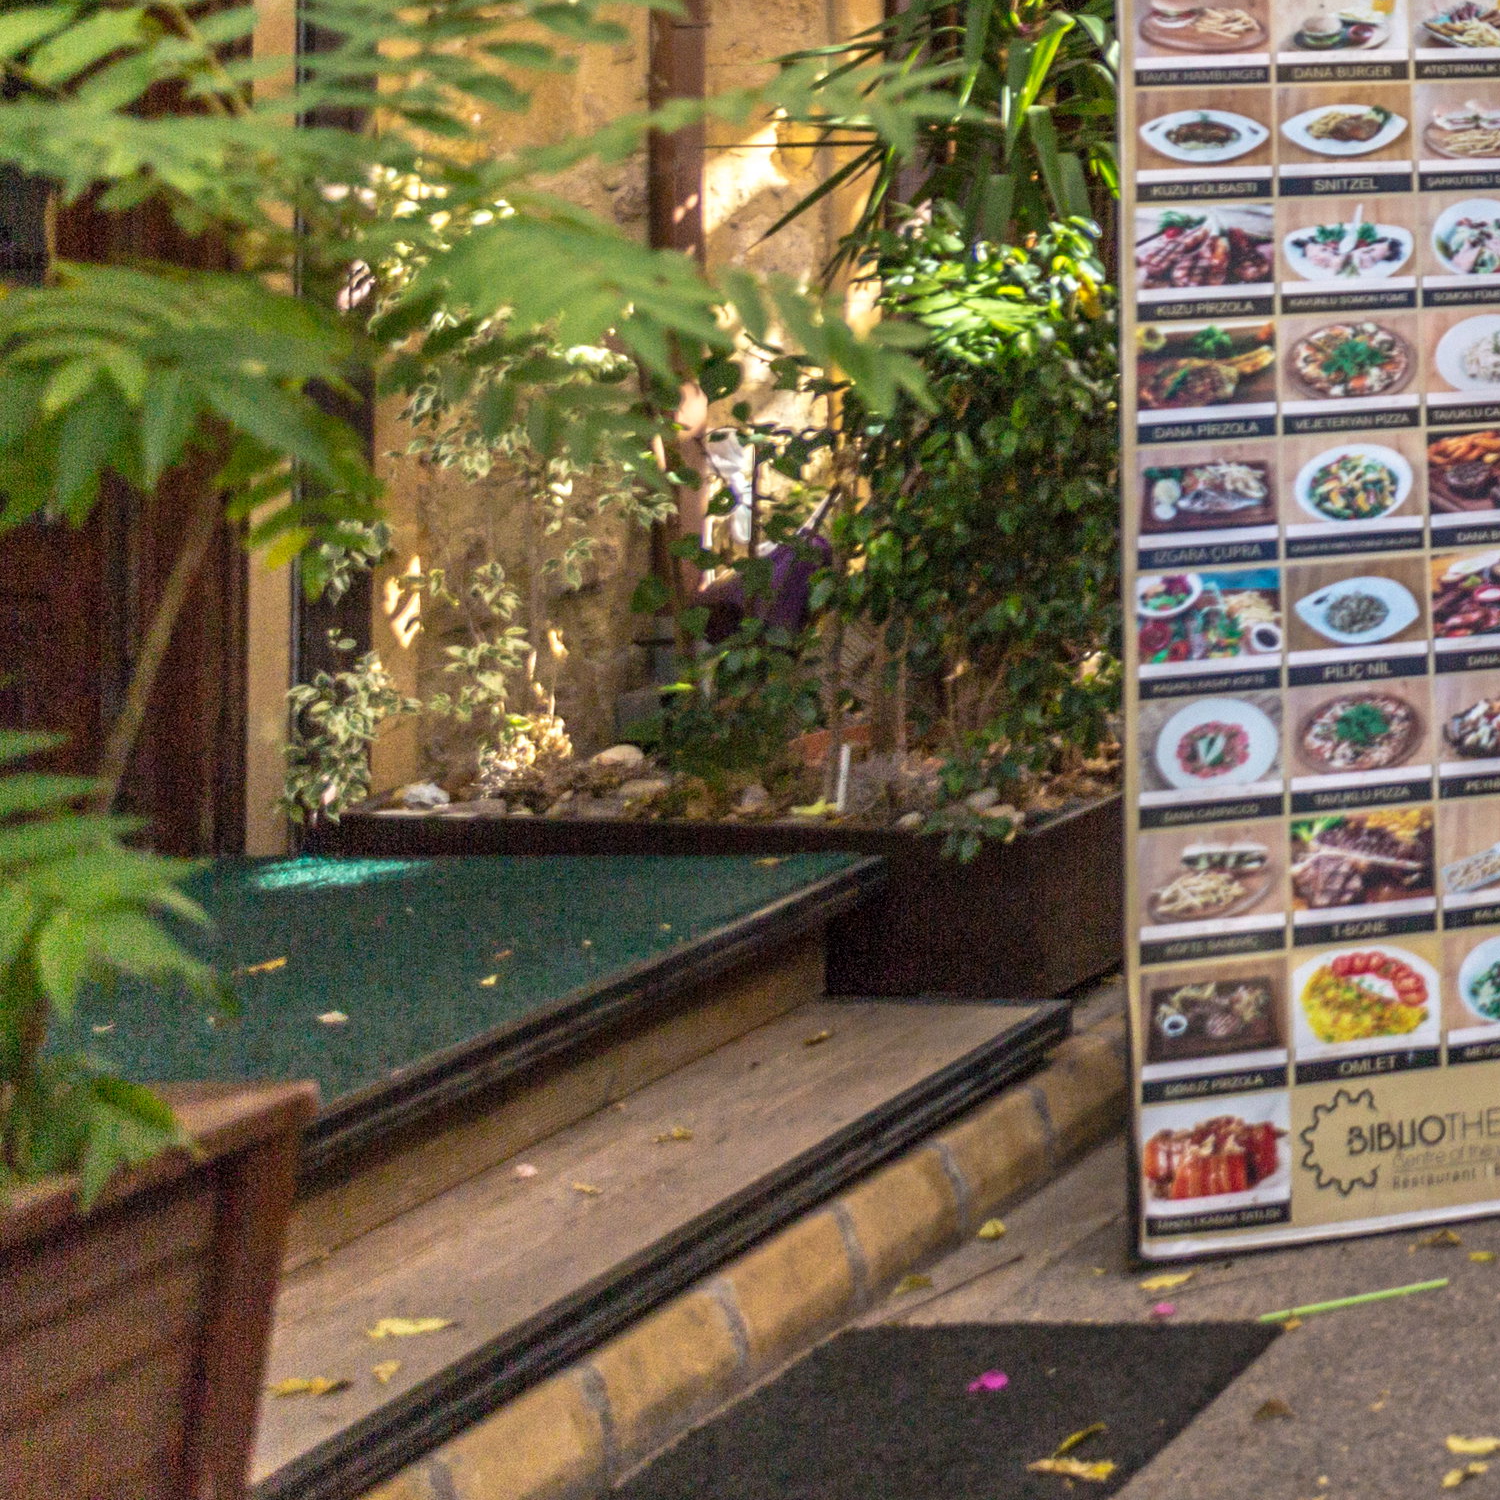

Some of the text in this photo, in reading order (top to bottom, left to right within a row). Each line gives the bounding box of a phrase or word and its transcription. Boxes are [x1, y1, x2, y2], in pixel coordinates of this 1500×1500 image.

[1183, 67, 1267, 82] HAMBURGER
[1293, 65, 1393, 80] DANA BURGER
[1152, 184, 1190, 197] KUZU
[1156, 303, 1194, 318] KUZU
[1153, 425, 1195, 440] DANA
[1457, 530, 1489, 543] DANA
[1339, 1054, 1398, 1077] OMLET
